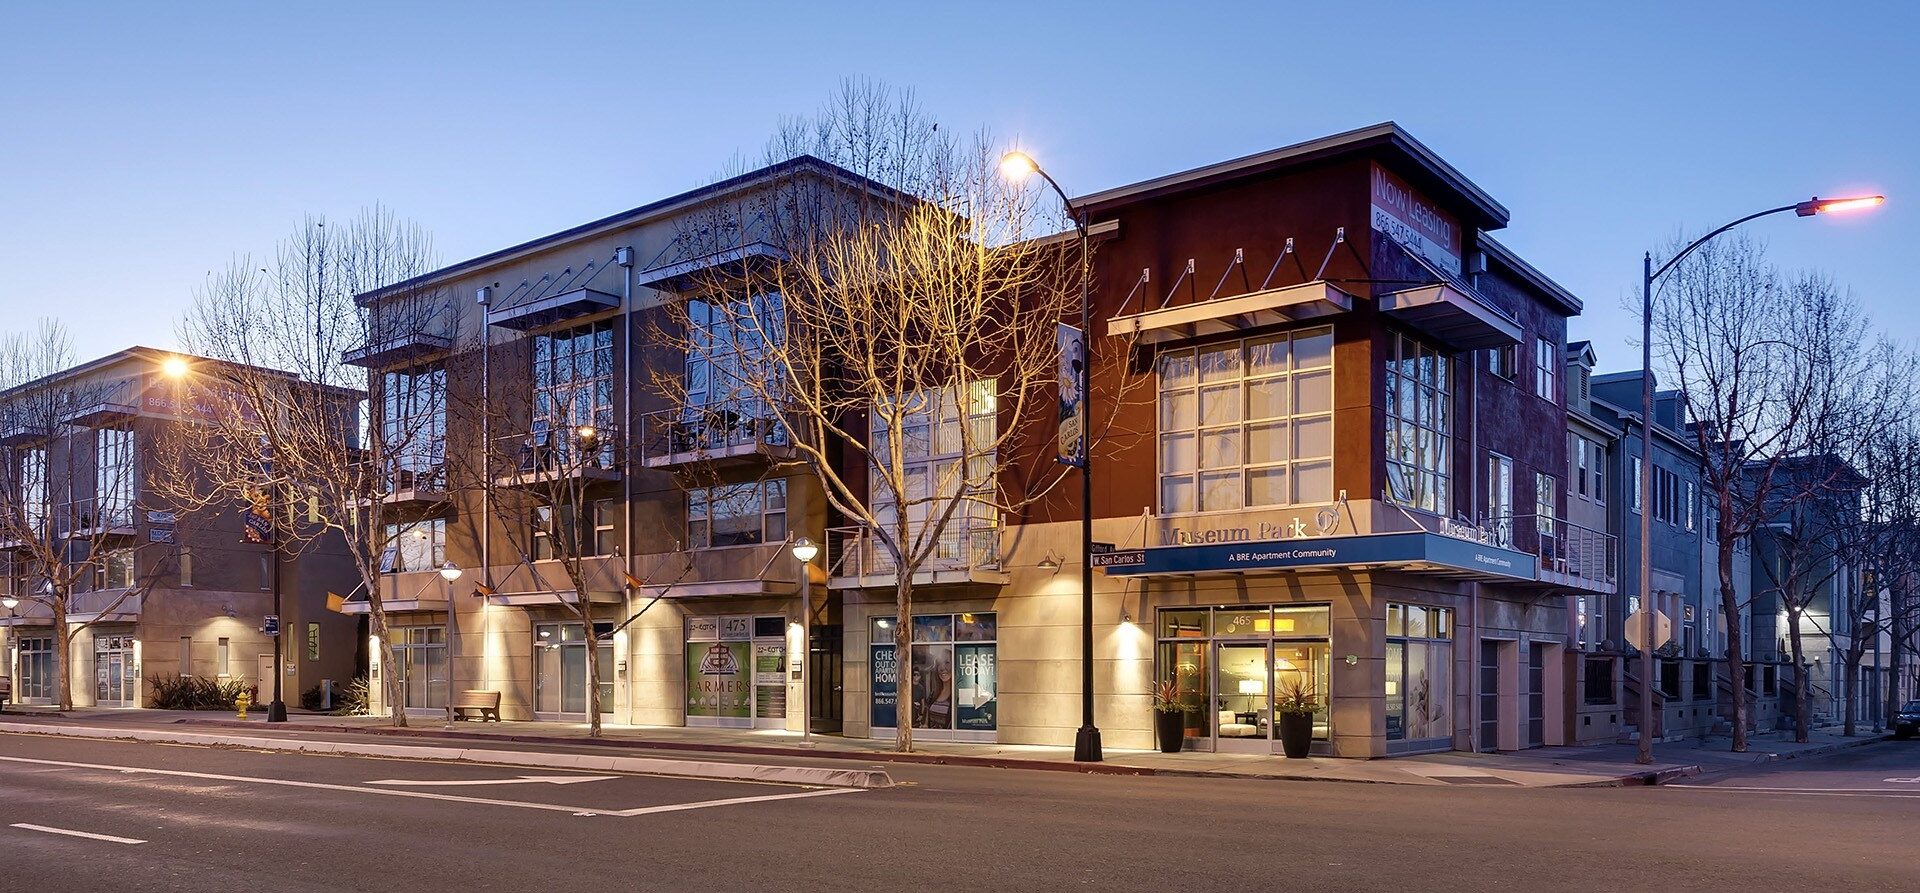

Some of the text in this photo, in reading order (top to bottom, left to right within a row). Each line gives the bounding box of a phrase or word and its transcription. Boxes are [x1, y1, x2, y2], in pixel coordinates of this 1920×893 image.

[1376, 168, 1450, 249] Now Leasing
[1160, 518, 1308, 546] Museum Park
[1439, 517, 1477, 541] Museum
[1101, 556, 1112, 565] San
[1113, 555, 1134, 564] Carlos
[1136, 553, 1145, 562] St
[1237, 553, 1250, 561] BRE
[1252, 552, 1290, 563] Apartment
[1292, 548, 1337, 558] Community
[726, 619, 746, 631] 475
[1233, 615, 1251, 625] 465
[875, 651, 897, 660] CHEC
[959, 654, 993, 666] LEASE
[960, 666, 994, 676] TODAY!
[875, 674, 897, 682] HOM
[688, 681, 751, 693] FARMERS
